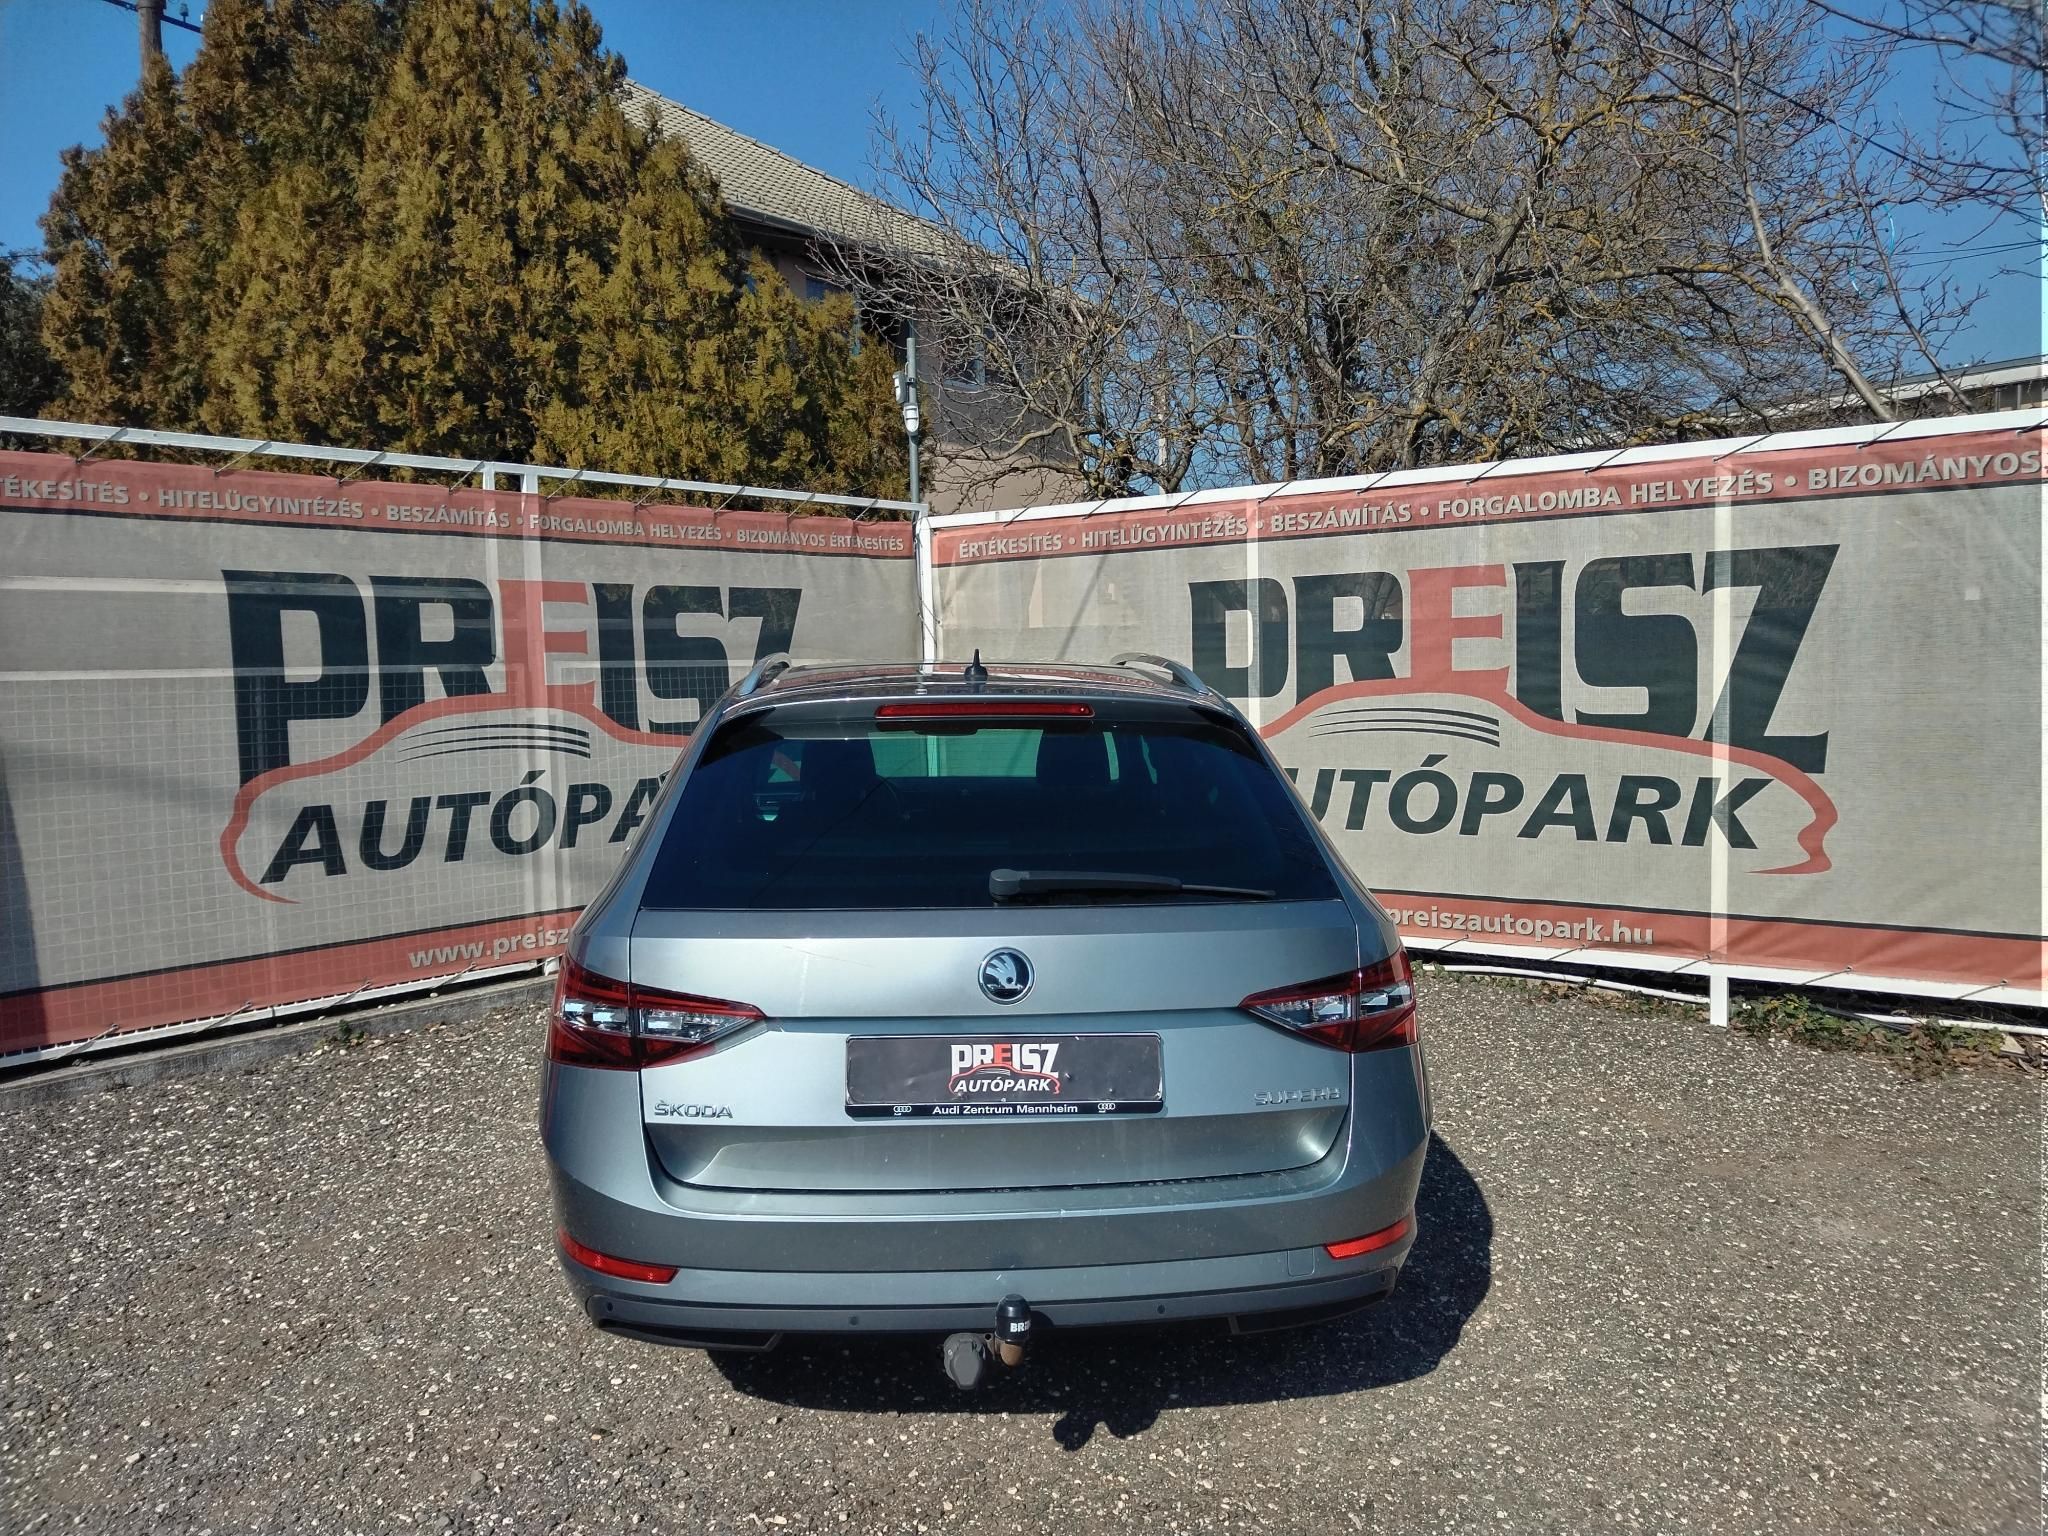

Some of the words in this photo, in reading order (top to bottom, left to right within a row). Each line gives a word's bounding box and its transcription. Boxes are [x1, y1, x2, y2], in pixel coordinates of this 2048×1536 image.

[158, 488, 364, 520] HITELÜGYINTÉZÉS
[386, 504, 511, 528] BESZÁMÍTÁS
[529, 514, 646, 536] FORGALOMBA
[650, 523, 722, 541] HELYEZÉS
[958, 531, 1063, 560] ÉRTÉKESÍTÉS
[1081, 514, 1248, 549] HITELÜGYINTÉZÉS
[1271, 500, 1412, 533] BESZÁMÍTÁS
[1438, 486, 1623, 520] FORGALOMBA
[1629, 470, 1774, 511] HELYEZÉS
[1807, 450, 2042, 490] BIZOMÁNYOS
[1188, 543, 1841, 775] PREISZ
[1283, 753, 1774, 850] UTÓPARK
[259, 769, 672, 885] AUTÓPA
[1384, 905, 1654, 945] preiszautopark.hu
[408, 926, 570, 969] www.preisz
[950, 1042, 1060, 1077] PREISZ
[954, 1076, 1052, 1093] AUTÓPARK
[1253, 1087, 1342, 1106] SUPERB
[654, 1100, 734, 1119] ŠKODA
[932, 1105, 959, 1115] Audi
[963, 1104, 1013, 1115] Zentrum
[1016, 1103, 1078, 1114] Mannheim
